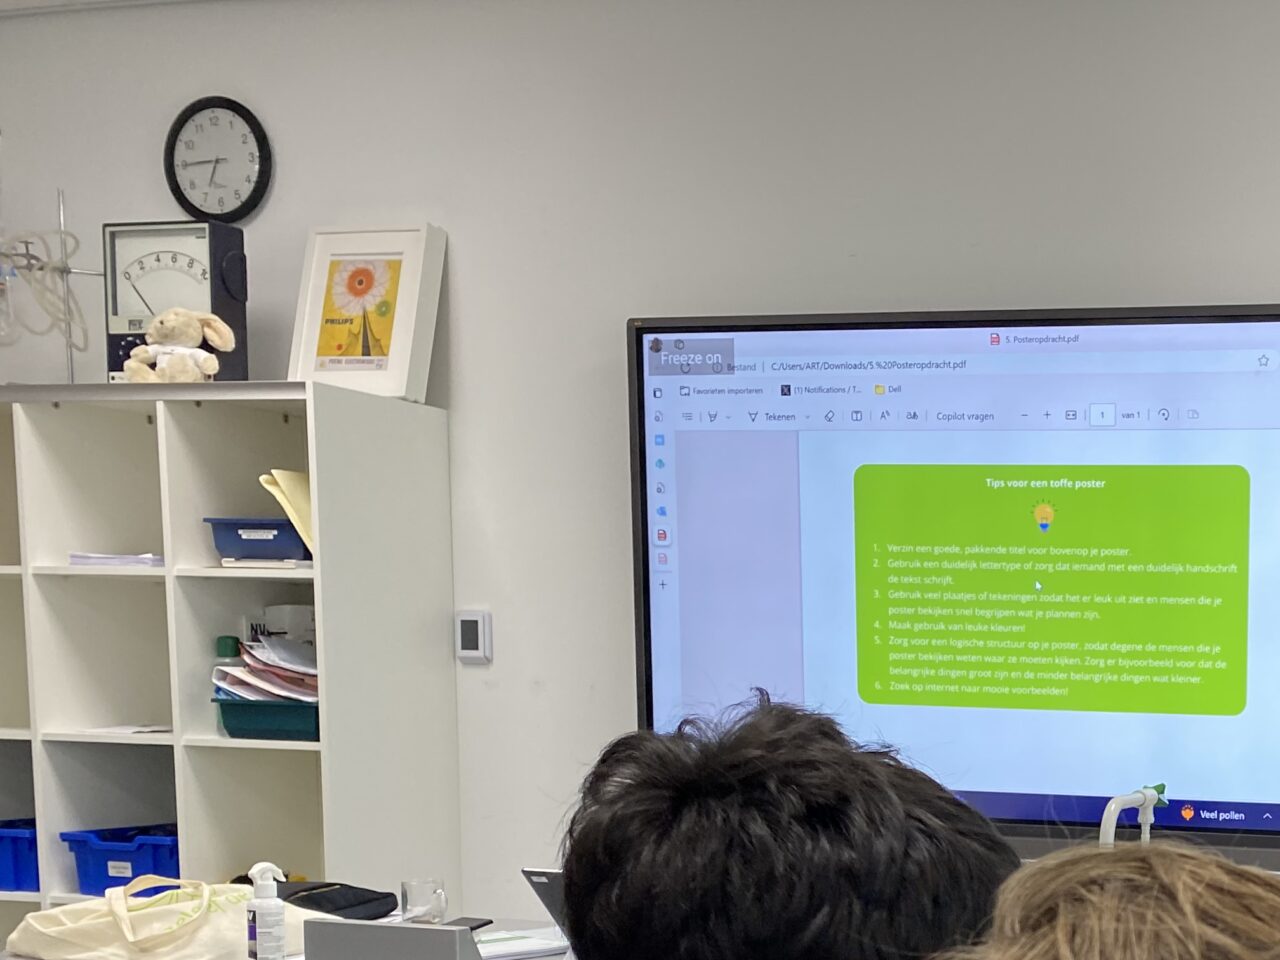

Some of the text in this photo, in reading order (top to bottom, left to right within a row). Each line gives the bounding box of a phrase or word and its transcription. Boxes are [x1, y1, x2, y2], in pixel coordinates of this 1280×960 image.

[208, 116, 220, 126] 12
[228, 120, 233, 130] 1
[241, 134, 248, 144] 2
[248, 152, 255, 163] 3
[245, 174, 251, 184] 4
[201, 192, 209, 202] 7
[234, 190, 241, 200] 5
[217, 197, 225, 207] 6
[155, 254, 161, 263] 4
[171, 254, 177, 263] 6
[187, 259, 195, 268] 8
[138, 261, 146, 270] 2
[124, 272, 131, 281] 0
[1014, 335, 1079, 344] Posteropdracht.pdf
[661, 352, 721, 364] Freeze on
[727, 363, 756, 372] Bestand
[727, 388, 763, 396] importeren
[794, 386, 845, 395] (1) Notifications
[889, 385, 901, 393] Dell
[765, 412, 795, 422] Tekenen
[937, 412, 994, 424] Copilot vragen
[986, 478, 1005, 489] Tips
[1050, 479, 1072, 488] toffe
[1075, 479, 1106, 490] poster
[888, 544, 913, 553] Verzin
[964, 545, 1006, 555] pakkende
[1009, 546, 1025, 554] titel
[1050, 547, 1088, 557] bovenop
[1090, 548, 1100, 557] je
[888, 559, 921, 568] Gebruik
[941, 560, 977, 571] duidelijk
[980, 561, 1021, 571] lettertype
[1024, 561, 1033, 570] of
[1035, 563, 1054, 572] zorg
[1056, 562, 1070, 571] dat
[1072, 563, 1105, 571] iemand
[1108, 564, 1124, 572] met
[1146, 563, 1184, 575] duidelijk
[1186, 564, 1237, 573] handschrift
[888, 575, 898, 583] de
[901, 576, 921, 584] tekst
[1200, 810, 1245, 821] Veel pollen
